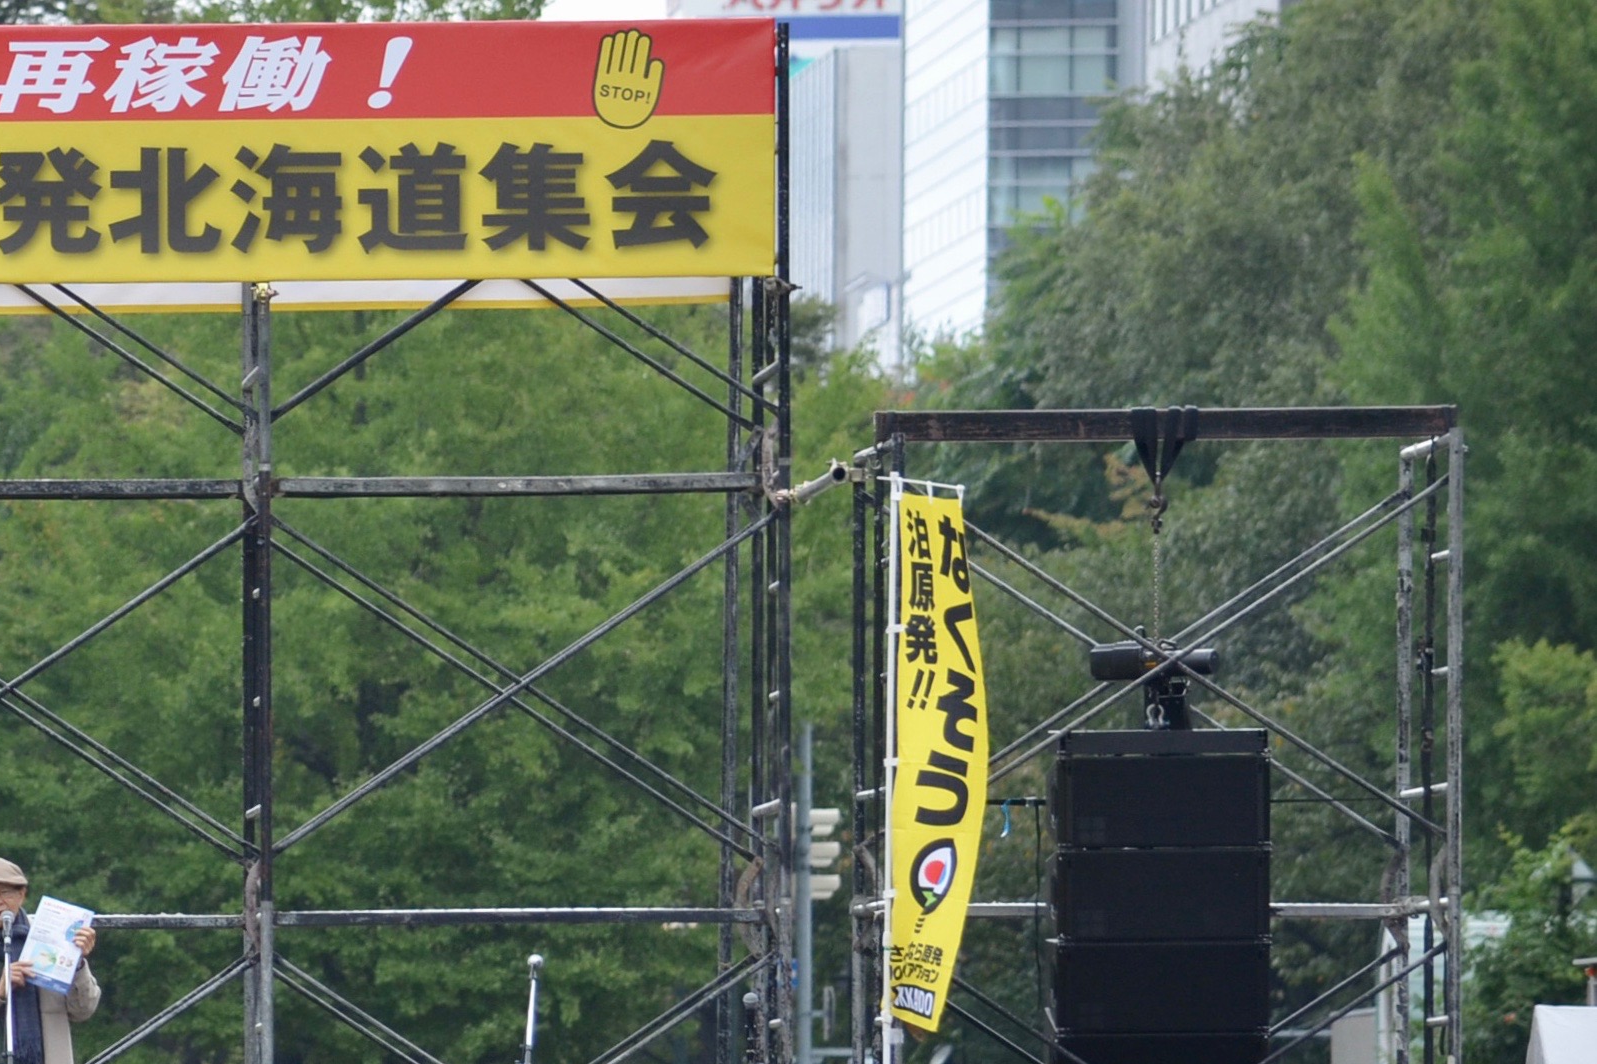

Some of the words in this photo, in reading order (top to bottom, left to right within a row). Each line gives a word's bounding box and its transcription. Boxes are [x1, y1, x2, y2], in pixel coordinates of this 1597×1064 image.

[599, 84, 651, 104] STOP!
[914, 514, 979, 827] なくそう
